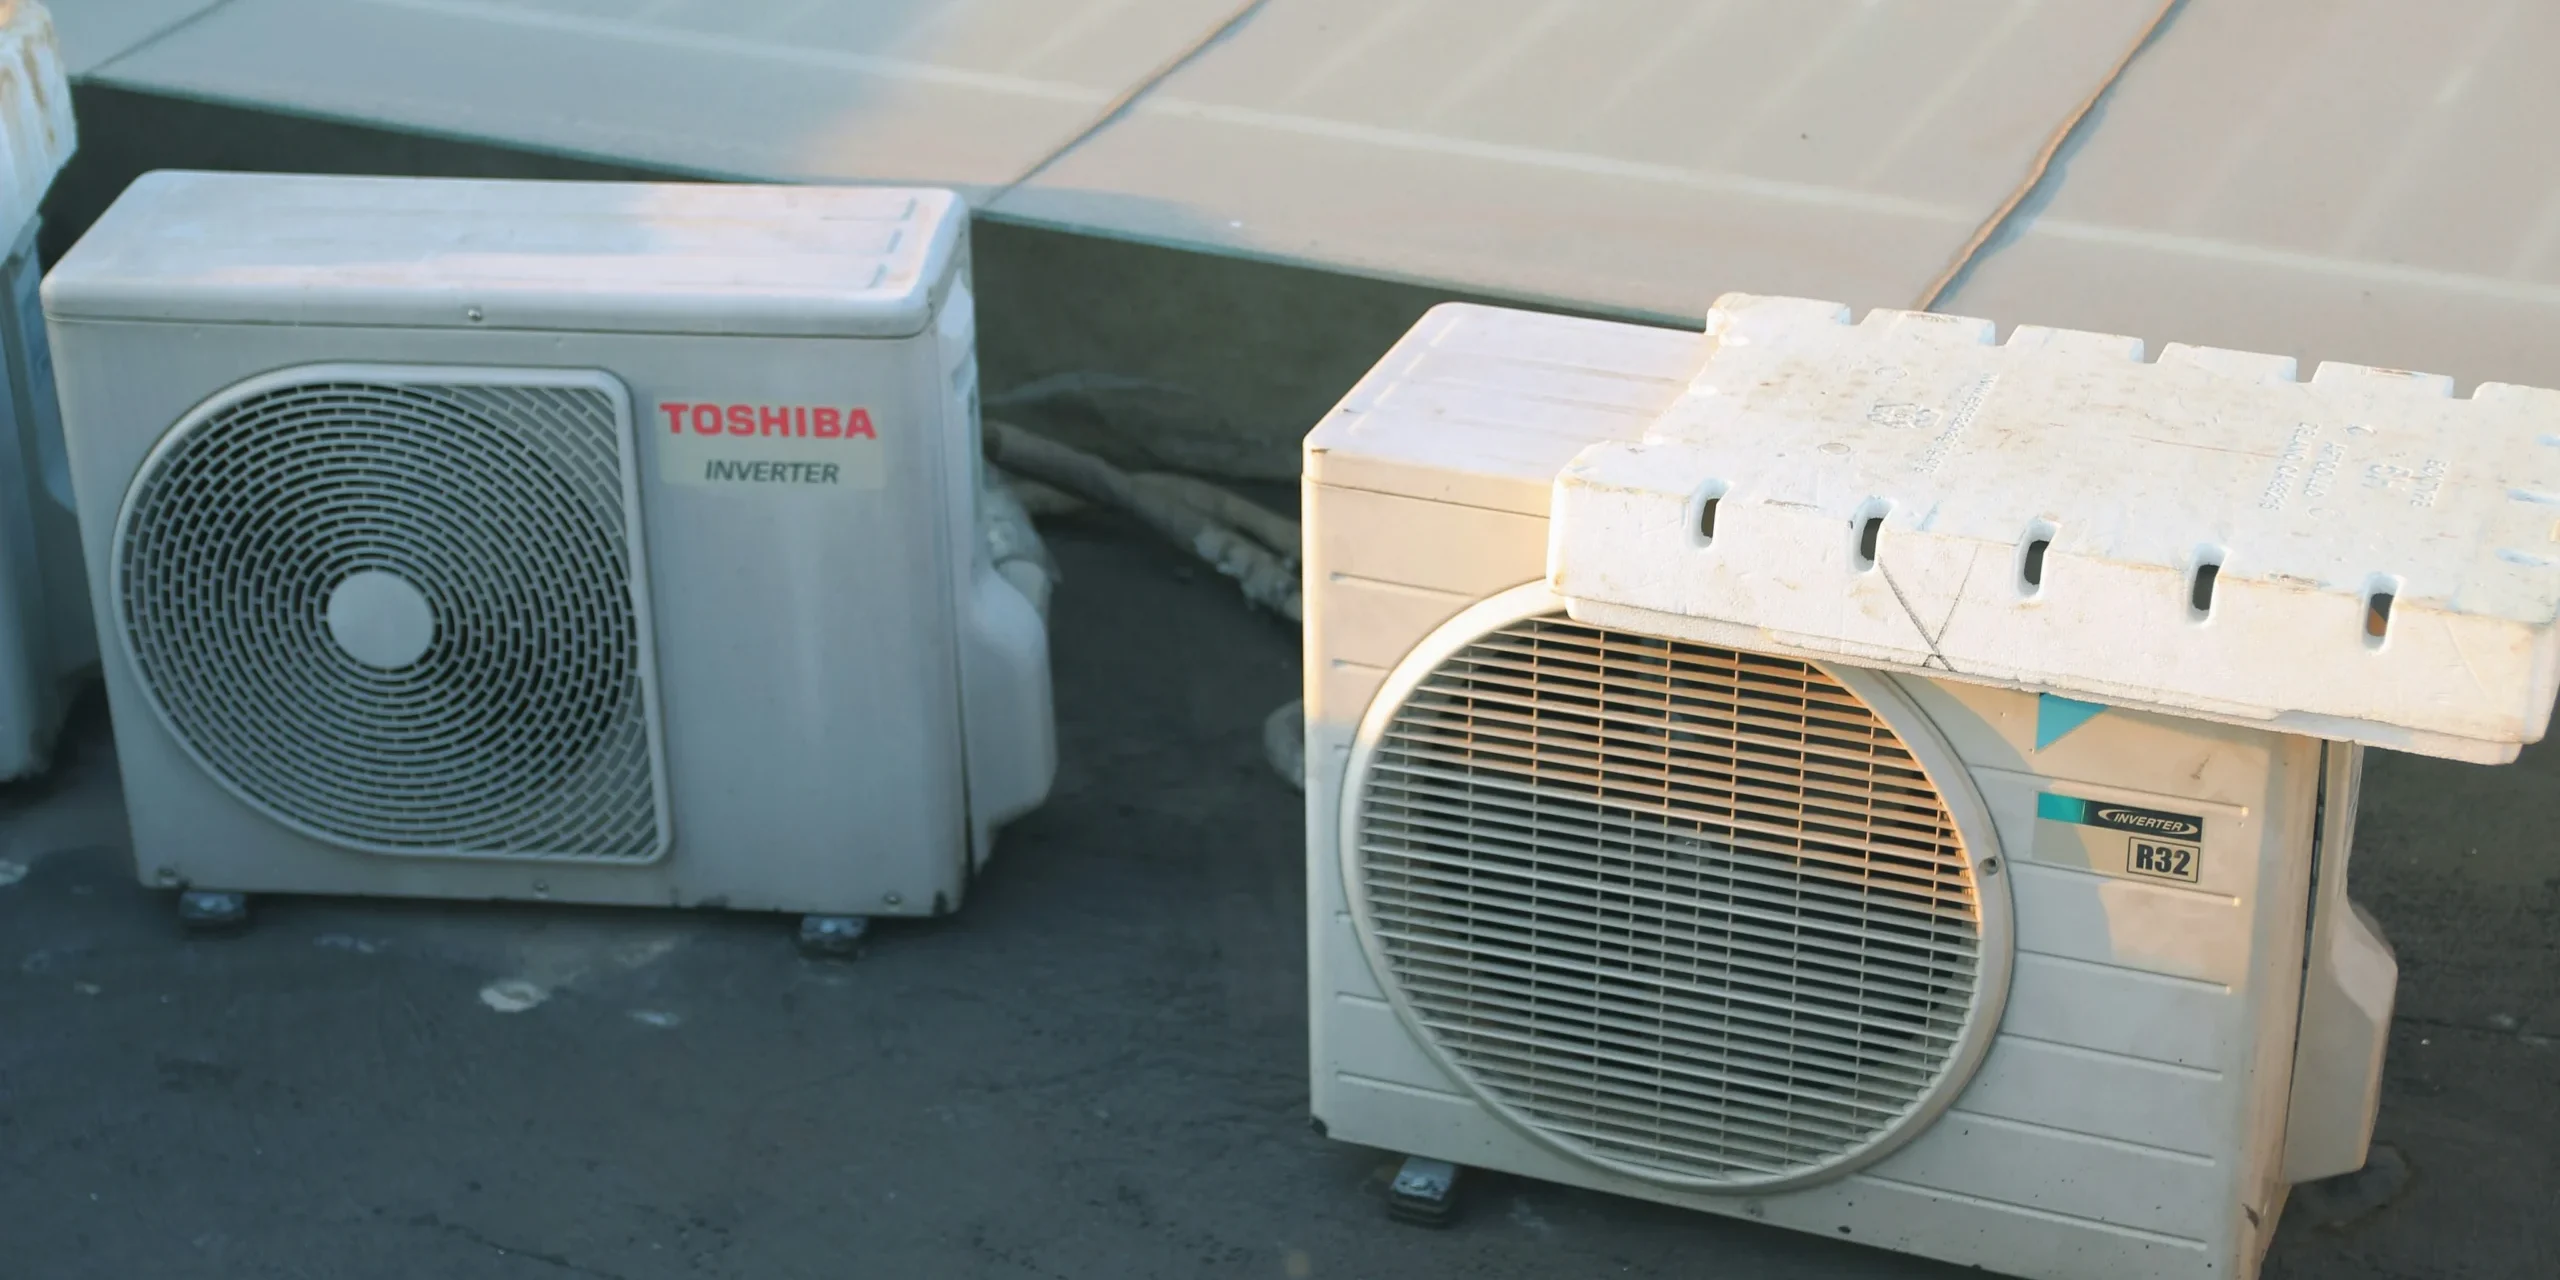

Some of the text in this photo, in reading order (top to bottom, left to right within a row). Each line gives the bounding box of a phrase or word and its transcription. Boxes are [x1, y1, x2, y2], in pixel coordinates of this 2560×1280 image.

[659, 403, 878, 440] TOSHIBA
[705, 459, 840, 485] INVERTER
[2113, 812, 2184, 832] INVERTER
[2135, 843, 2191, 876] R32
